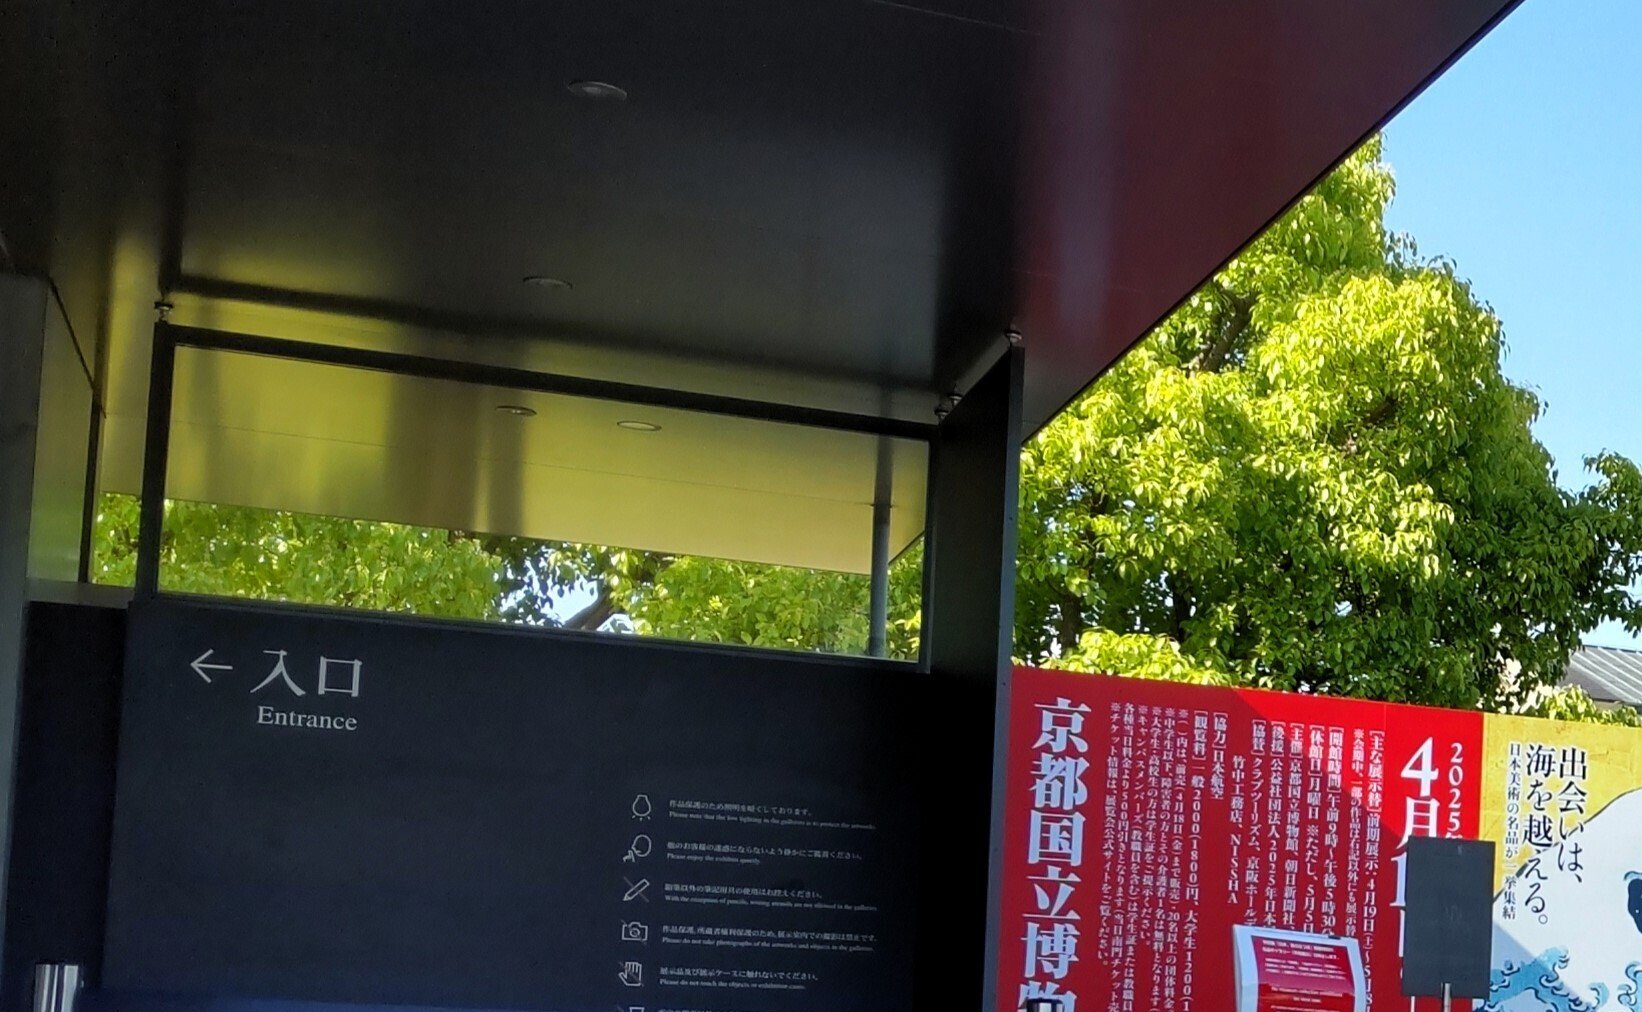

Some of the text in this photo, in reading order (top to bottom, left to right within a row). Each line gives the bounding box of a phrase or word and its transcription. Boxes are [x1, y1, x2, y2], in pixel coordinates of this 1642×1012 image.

[249, 649, 363, 697] 入口
[257, 705, 359, 732] Entrance
[1446, 742, 1464, 839] 2025
[1502, 742, 1521, 920] 日本美術の名品が一挙集結
[1522, 743, 1556, 925] 海を越える。
[1557, 746, 1588, 884] 出会いは、
